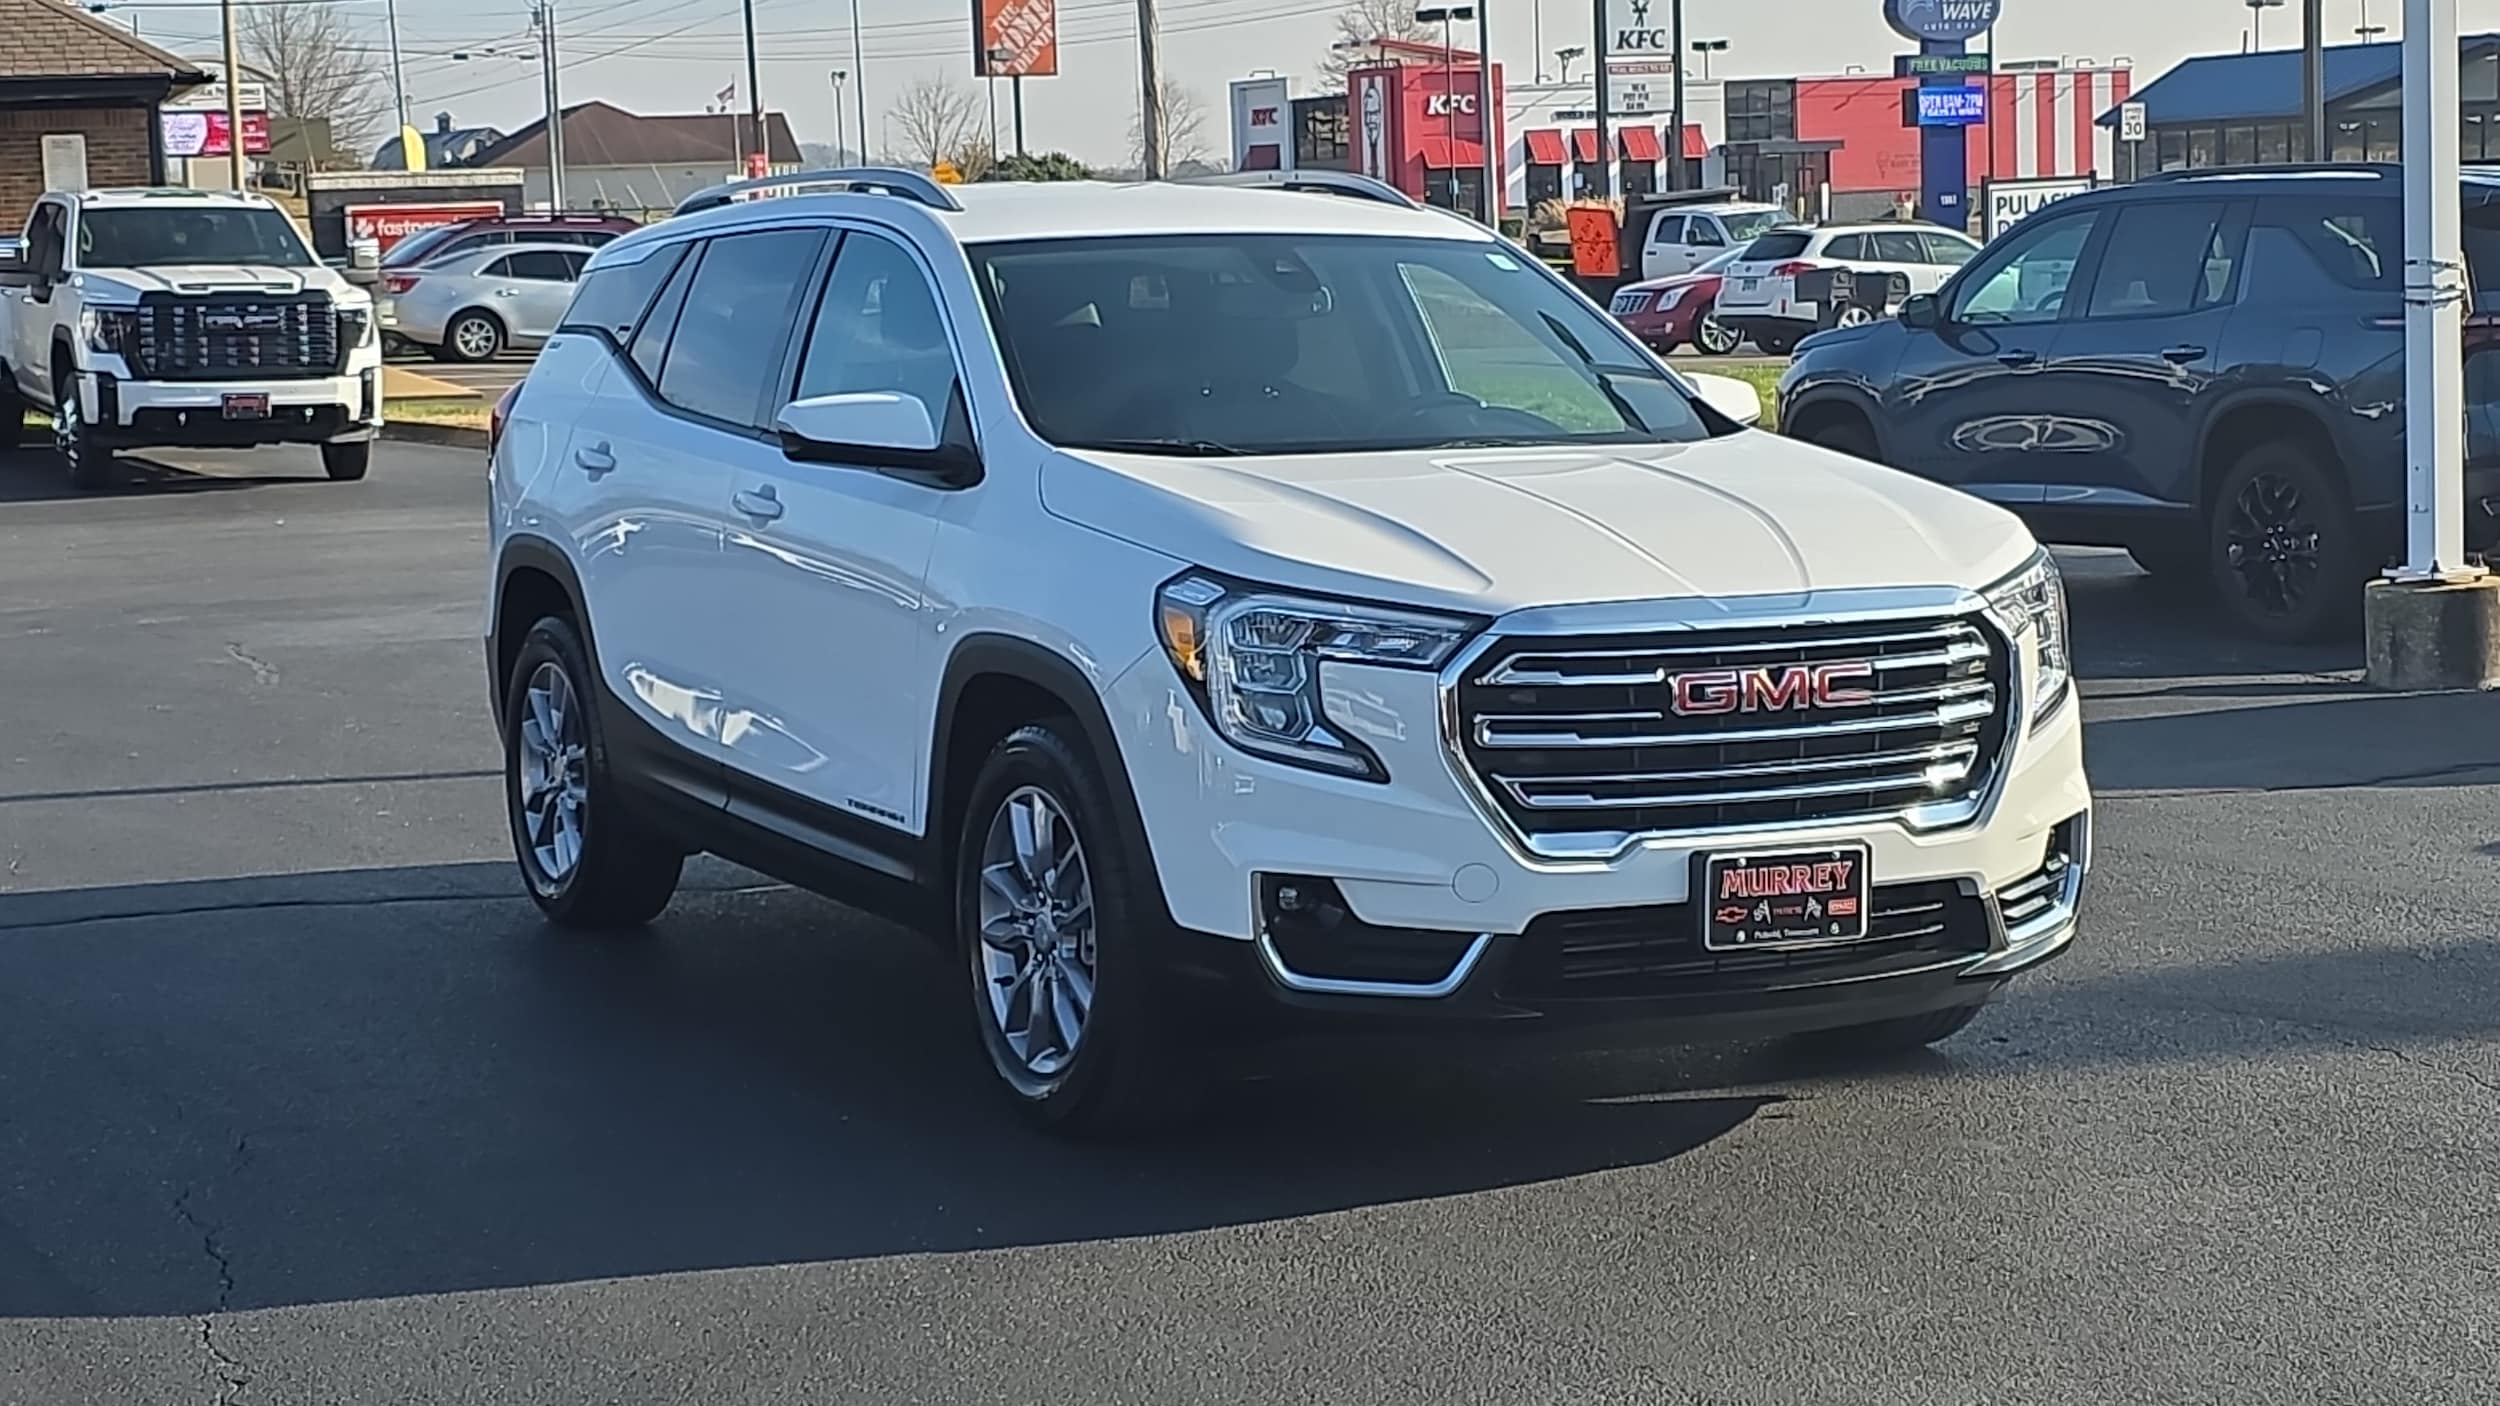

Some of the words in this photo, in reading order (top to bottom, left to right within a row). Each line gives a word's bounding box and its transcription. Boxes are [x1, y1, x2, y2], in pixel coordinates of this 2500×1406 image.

[991, 0, 1020, 33] THE
[1942, 3, 1993, 20] WAVE
[1923, 23, 1950, 31] AUTO
[1956, 22, 1977, 30] SPA
[1014, 22, 1054, 73] DEPOT
[1616, 29, 1665, 50] KFC
[1911, 59, 1938, 72] FREE
[1427, 95, 1476, 115] KFC
[1920, 95, 1941, 108] OPEN
[1251, 108, 1278, 126] KFC
[2125, 122, 2142, 136] 30
[1668, 662, 1873, 716] GMC
[1720, 861, 1854, 899] MURREY
